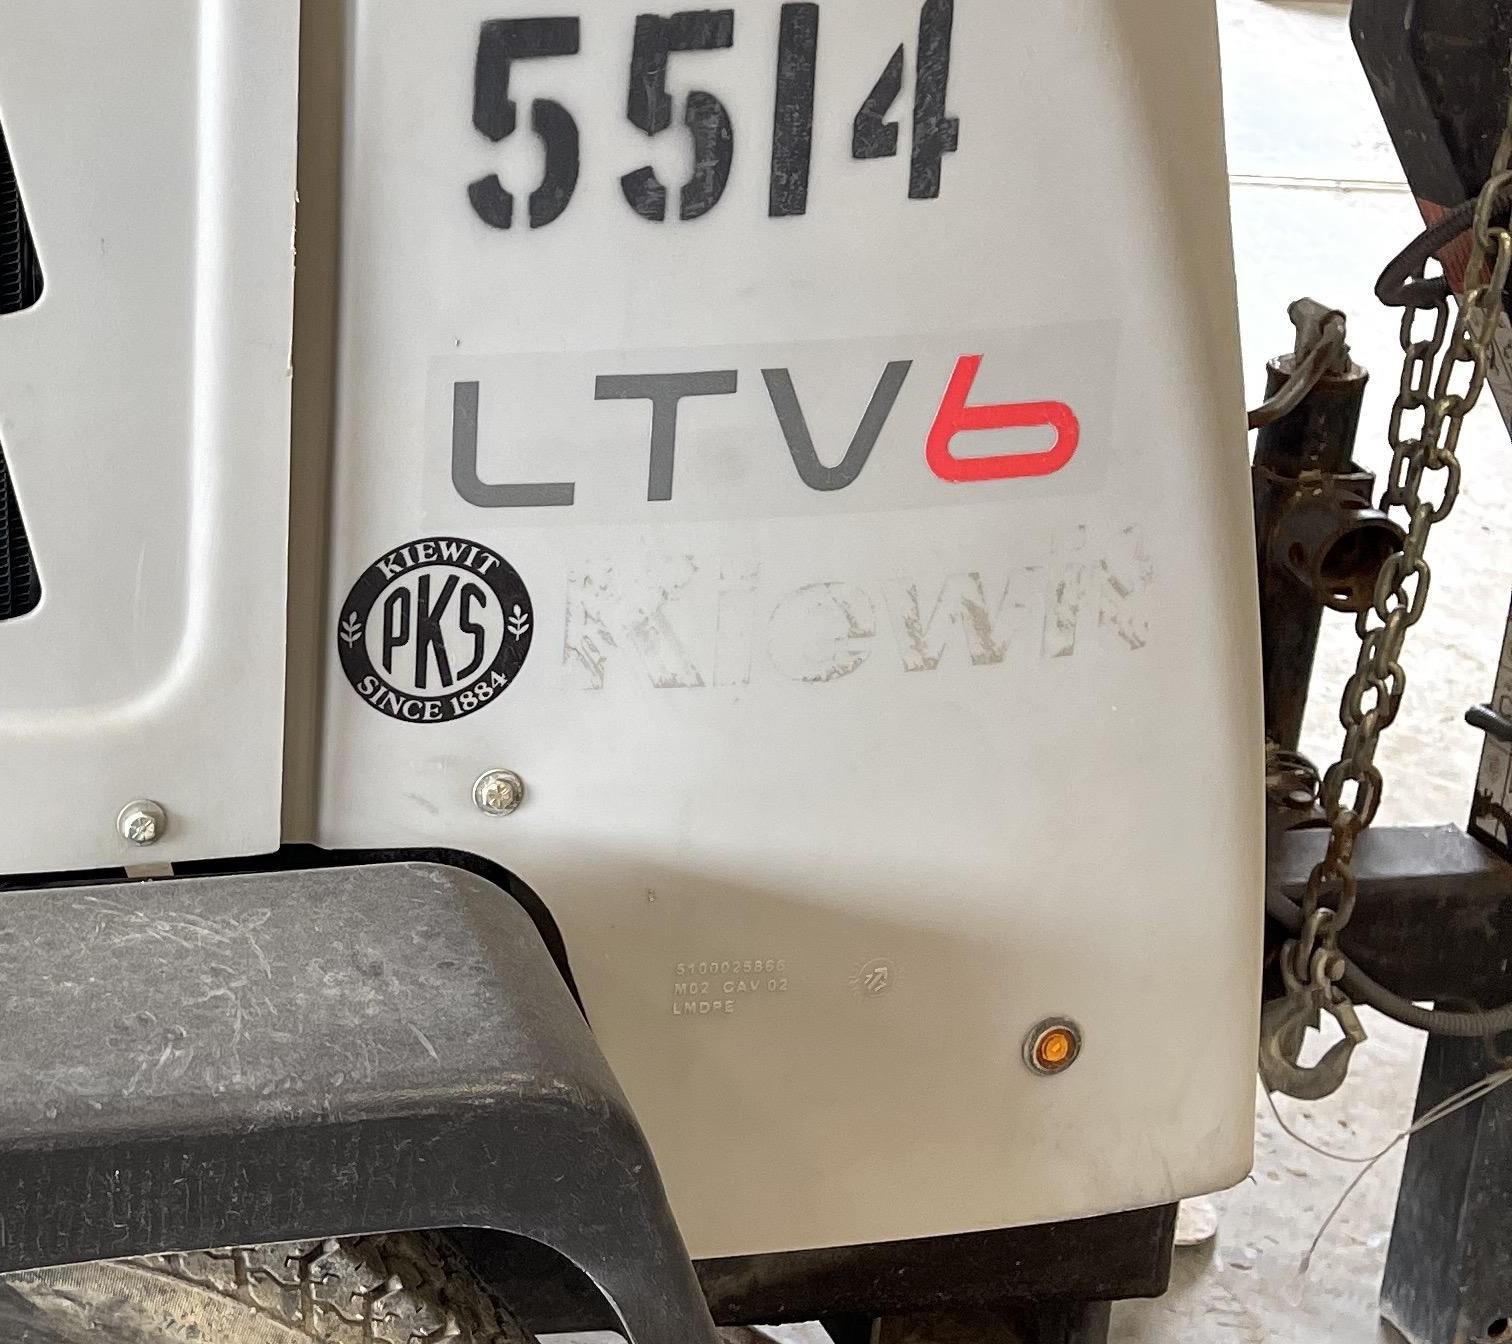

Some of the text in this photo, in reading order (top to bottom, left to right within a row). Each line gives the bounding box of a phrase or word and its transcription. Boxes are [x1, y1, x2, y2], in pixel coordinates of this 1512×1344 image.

[451, 353, 1080, 508] LTV6
[376, 540, 501, 580] KIEWIT
[382, 574, 487, 689] PKS
[357, 670, 509, 721] SINCE 1884
